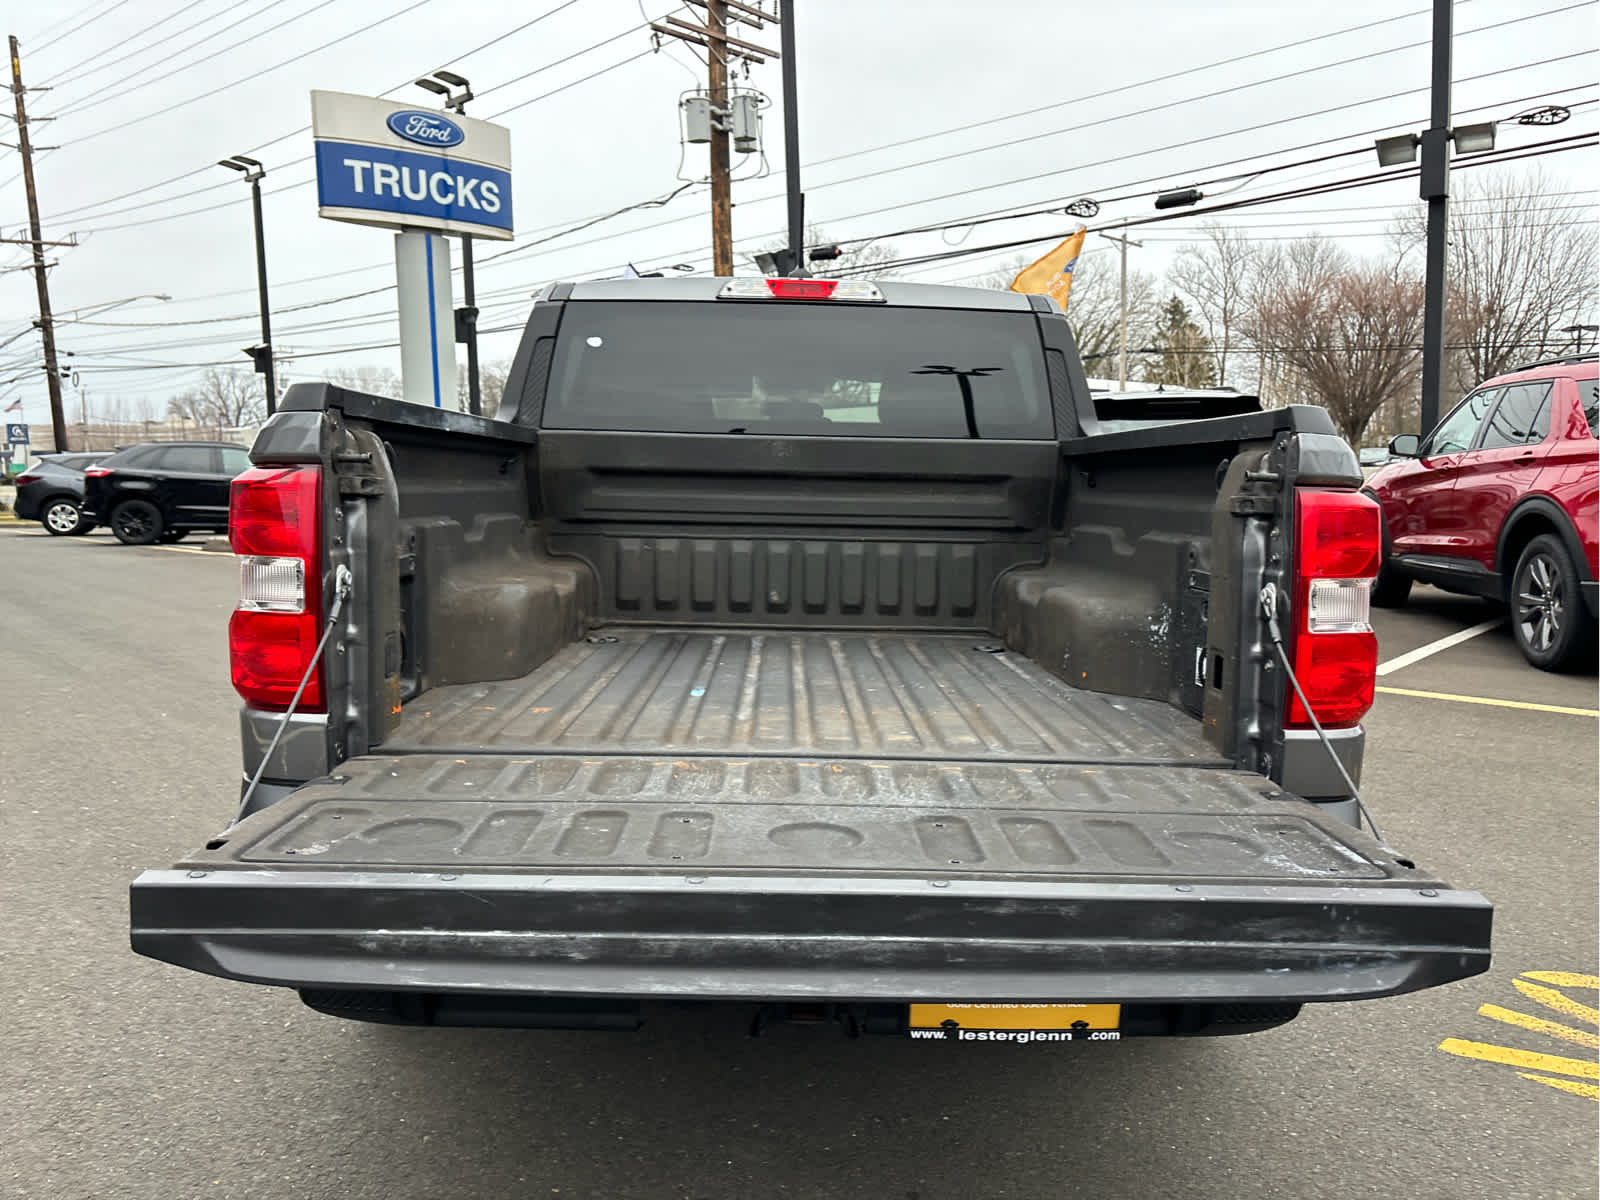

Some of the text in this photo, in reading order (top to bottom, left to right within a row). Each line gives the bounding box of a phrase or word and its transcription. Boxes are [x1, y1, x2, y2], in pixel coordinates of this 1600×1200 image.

[405, 115, 450, 141] Ford
[343, 158, 501, 213] TRUCKS
[910, 1030, 1121, 1043] www. lesterglenn .com
